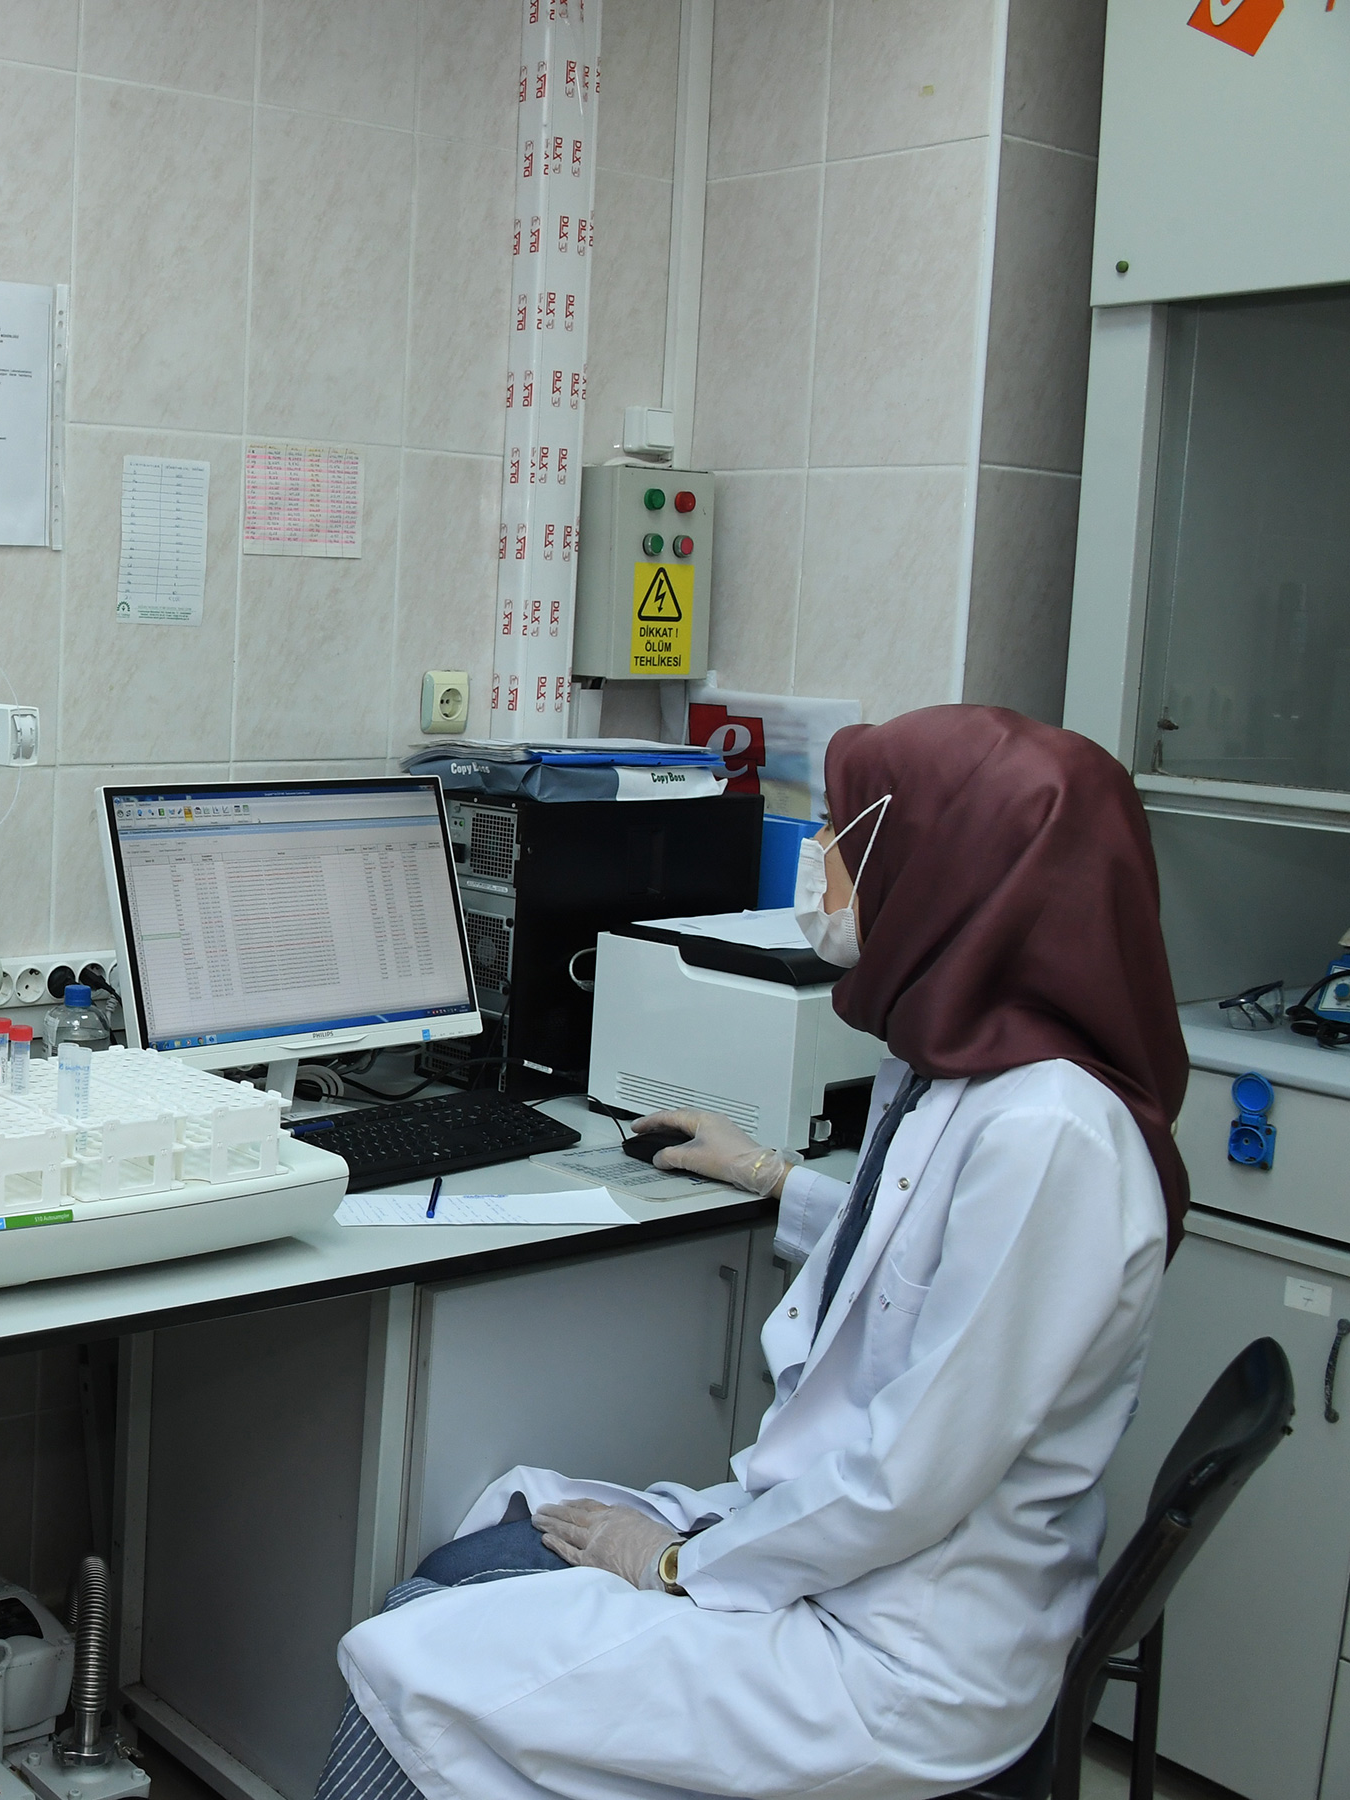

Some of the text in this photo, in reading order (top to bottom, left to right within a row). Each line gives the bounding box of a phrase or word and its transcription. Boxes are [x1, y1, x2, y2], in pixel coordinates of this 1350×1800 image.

[566, 60, 577, 85] DLX
[536, 74, 547, 98] DLX
[552, 136, 563, 161] DLX
[572, 139, 582, 165] DLX
[523, 152, 533, 178] DLX
[559, 215, 570, 240] DLX
[577, 218, 587, 244] DLX
[529, 228, 541, 253] DLX
[546, 292, 556, 317] DLX
[565, 294, 575, 319] DLX
[517, 306, 527, 331] DLX
[522, 382, 533, 407] DLX
[552, 370, 563, 395] DLX
[570, 372, 580, 397] DLX
[539, 446, 549, 471] DLX
[558, 448, 568, 473] DLX
[509, 459, 520, 484] DLX
[515, 535, 526, 560] DLX
[544, 524, 555, 549] DLX
[562, 525, 572, 550] DLX
[502, 611, 513, 635] DLX
[531, 600, 541, 625] DLX
[550, 600, 560, 625] DLX
[639, 624, 673, 638] DİKKAT
[645, 640, 672, 652] ÖLÜM
[634, 654, 682, 667] TEHLİKESİ
[507, 687, 519, 711] DLX
[536, 676, 547, 701] DLX
[554, 676, 565, 701] DLX
[450, 762, 472, 775] Copy
[312, 1030, 334, 1039] PHILIPS
[43, 1213, 70, 1221] Autosampler
